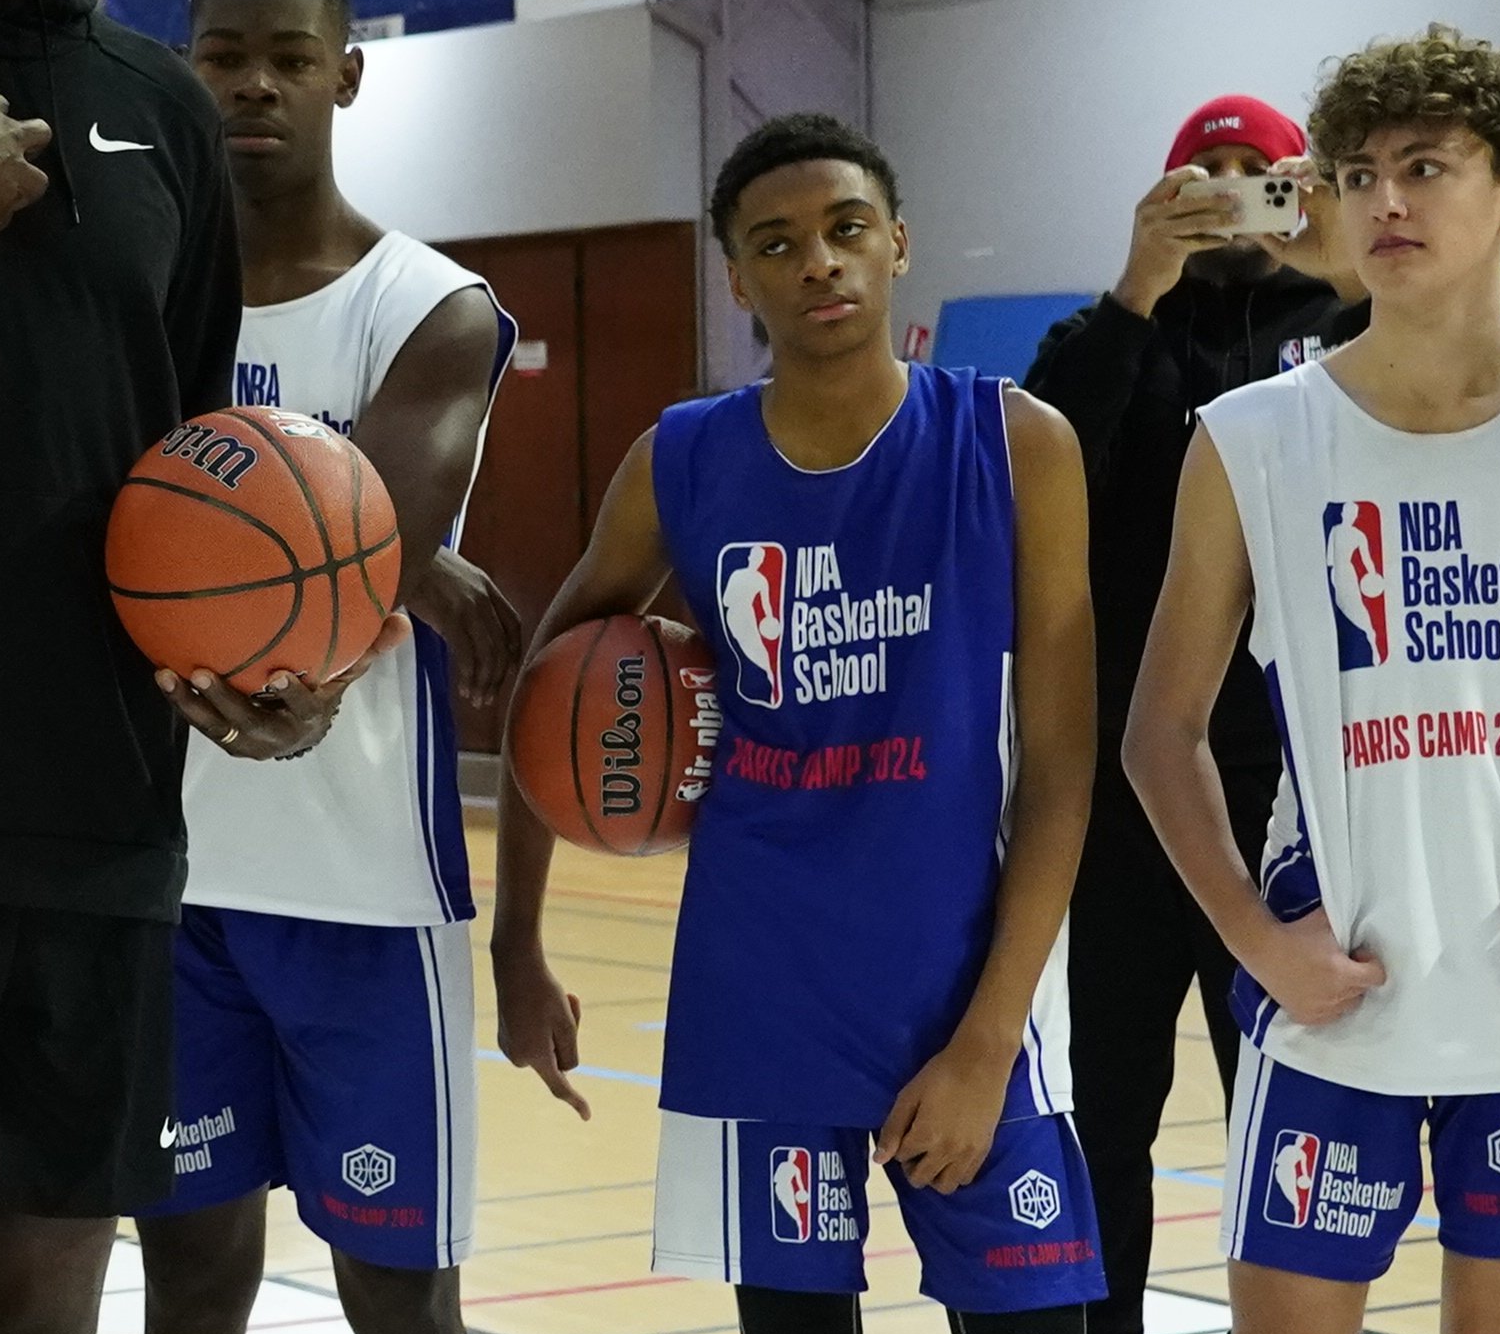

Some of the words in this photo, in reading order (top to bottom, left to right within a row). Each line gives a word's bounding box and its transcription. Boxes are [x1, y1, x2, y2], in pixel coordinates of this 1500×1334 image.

[1399, 501, 1462, 552] NBA
[794, 642, 887, 705] School
[600, 656, 645, 817] Wilson
[1342, 714, 1410, 772] PARIS
[1417, 710, 1488, 761] CAMP
[175, 1106, 237, 1148] ketball
[1325, 1141, 1359, 1175] NBA
[1313, 1202, 1377, 1238] School
